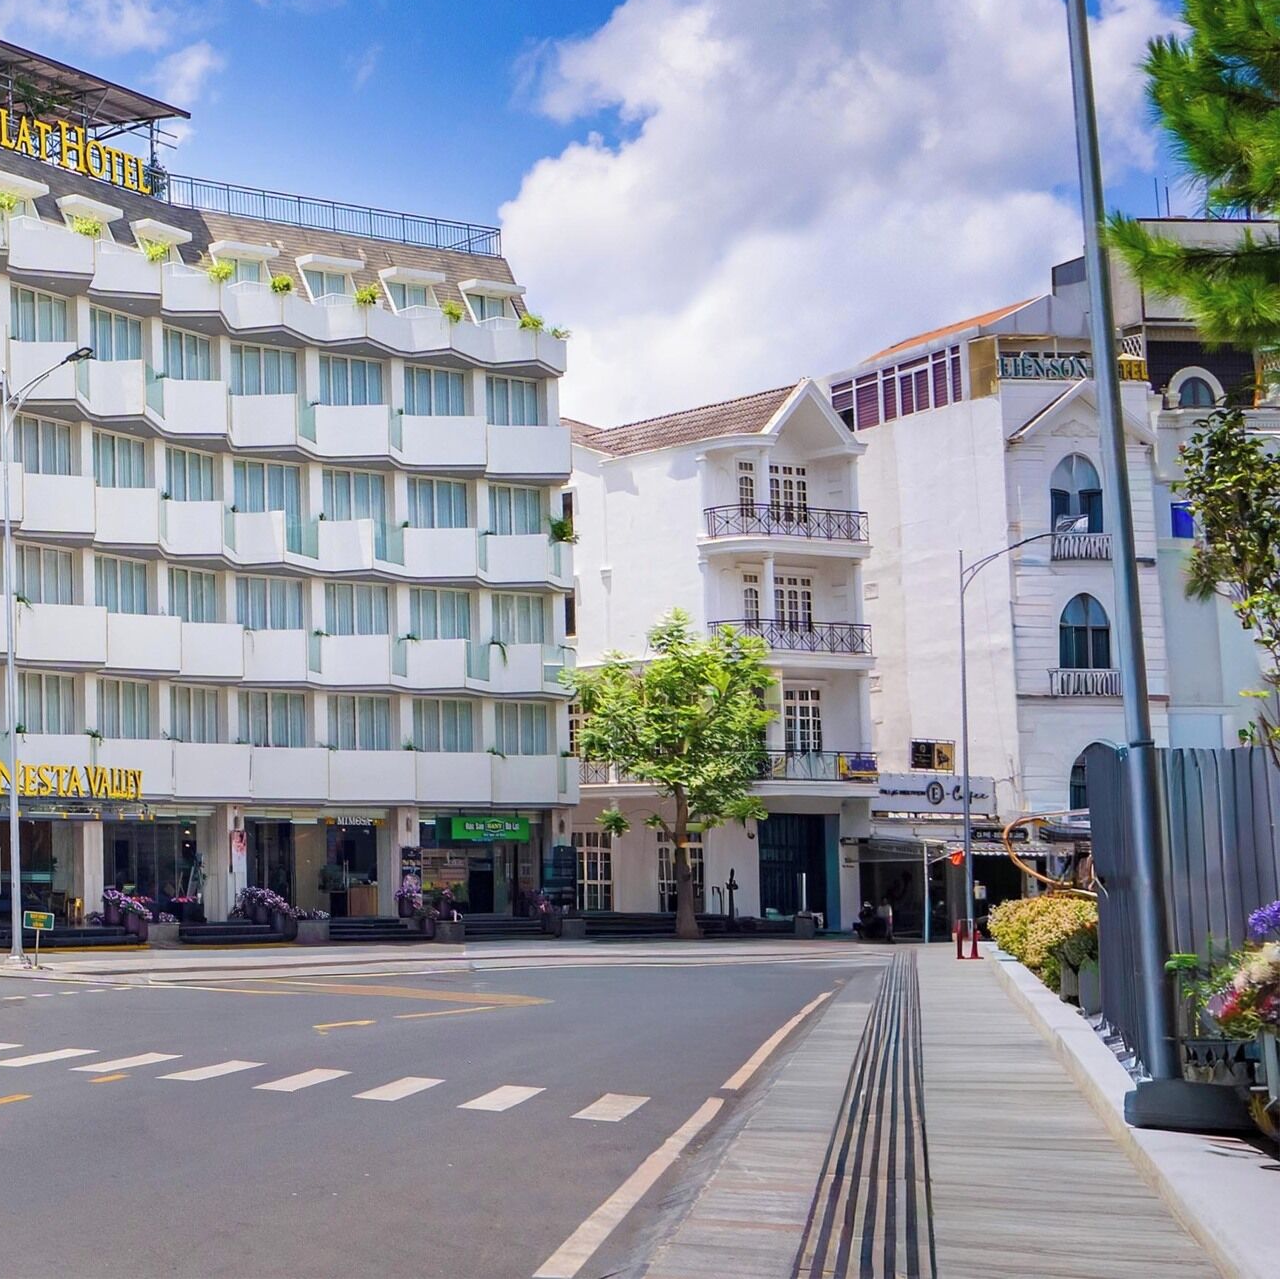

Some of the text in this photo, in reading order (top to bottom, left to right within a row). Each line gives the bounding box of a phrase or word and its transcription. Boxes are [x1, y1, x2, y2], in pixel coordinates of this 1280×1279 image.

[57, 119, 152, 196] HOTEL
[1117, 359, 1150, 381] TEL
[84, 765, 144, 801] VALLEY
[952, 785, 989, 804] Cofee
